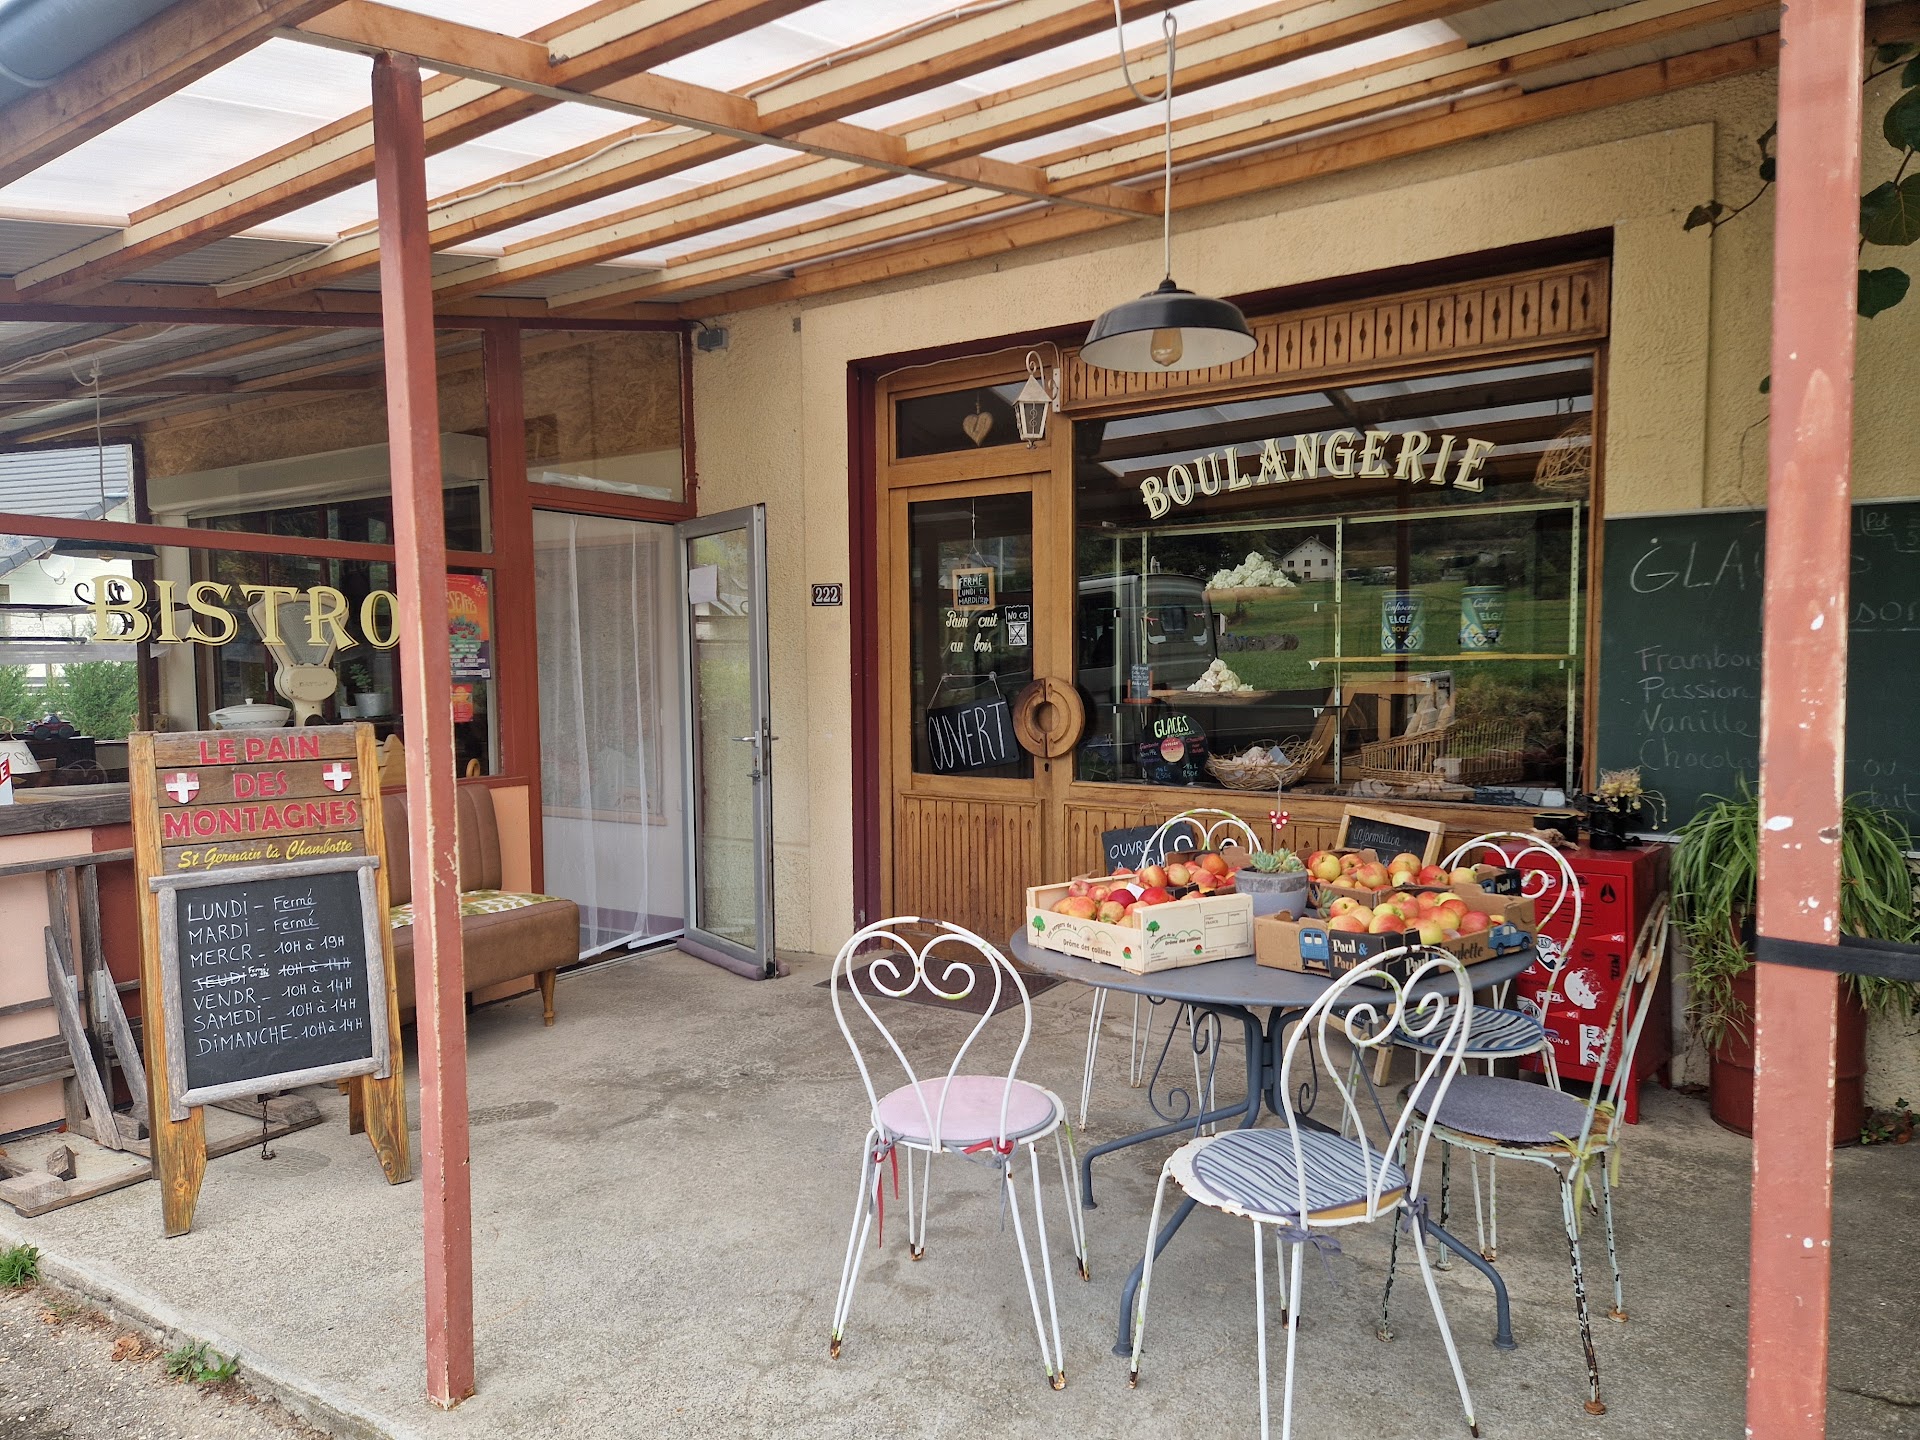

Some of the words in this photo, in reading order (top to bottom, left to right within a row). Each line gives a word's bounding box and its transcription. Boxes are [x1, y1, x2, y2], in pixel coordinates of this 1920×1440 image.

[1140, 430, 1495, 519] BOULANGERIE
[815, 586, 839, 603] 222
[86, 574, 401, 651] BISTRO
[946, 610, 968, 628] Pain
[978, 613, 998, 628] cuit
[1018, 612, 1028, 620] CB
[1388, 614, 1412, 624] ELGÉ
[950, 641, 964, 652] au
[974, 632, 992, 652] bois
[928, 701, 1006, 771] OUVERT
[1154, 715, 1189, 738] GLACES
[200, 739, 236, 765] LE
[244, 735, 321, 763] PAIN
[233, 770, 289, 799] DES
[163, 799, 358, 840] MONTAGNES
[178, 850, 199, 869] St
[203, 846, 262, 870] Germain
[266, 844, 280, 859] la
[285, 838, 353, 860] Chambotte
[273, 888, 317, 912] Fermé
[274, 910, 320, 933] Fermé
[190, 944, 252, 968] MERCR
[274, 940, 301, 954] 10H
[305, 938, 315, 952] à
[320, 935, 345, 950] 19H
[1063, 938, 1080, 949] Drôme
[1081, 944, 1090, 952] des
[1092, 946, 1112, 957] collines
[1331, 939, 1356, 954] Paul
[1358, 943, 1369, 956] &
[193, 988, 256, 1011] VENDR
[282, 984, 307, 998] 10H
[312, 980, 322, 994] à
[326, 977, 352, 994] 14H
[286, 1004, 313, 1018] 10H
[316, 1000, 328, 1013] à
[331, 998, 356, 1012] 14H
[301, 1021, 327, 1038] 10H
[339, 1018, 363, 1032] 14H
